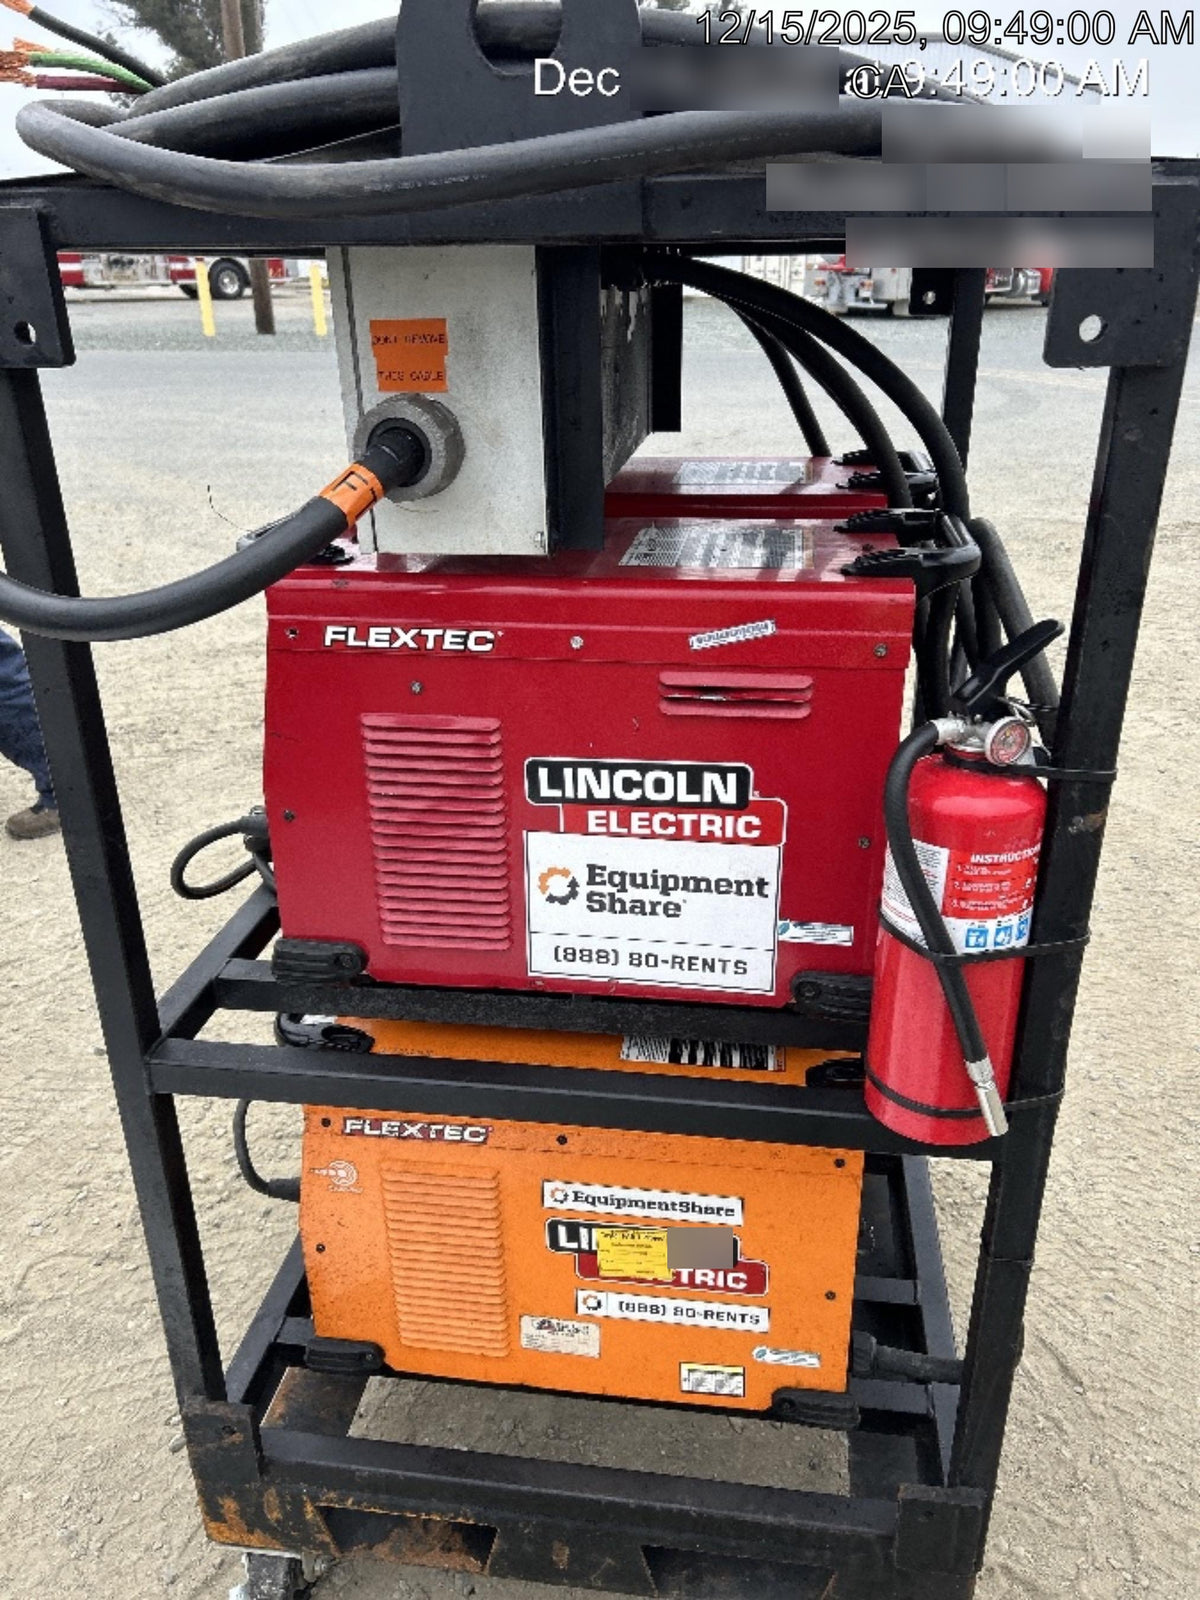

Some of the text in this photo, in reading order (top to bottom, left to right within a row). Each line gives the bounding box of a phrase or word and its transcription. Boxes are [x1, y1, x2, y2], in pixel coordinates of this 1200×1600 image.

[324, 625, 496, 652] FLEXTEC
[538, 767, 738, 804] LINCOLN
[587, 810, 762, 838] ELECTRIC
[586, 864, 770, 899] Equipment
[586, 891, 682, 918] Share
[553, 945, 748, 976] (888) 80-RENTS
[344, 1118, 489, 1143] FLEXTEC
[572, 1190, 735, 1218] EquipmentShare
[618, 1300, 761, 1326] (888) 80-RENTS
